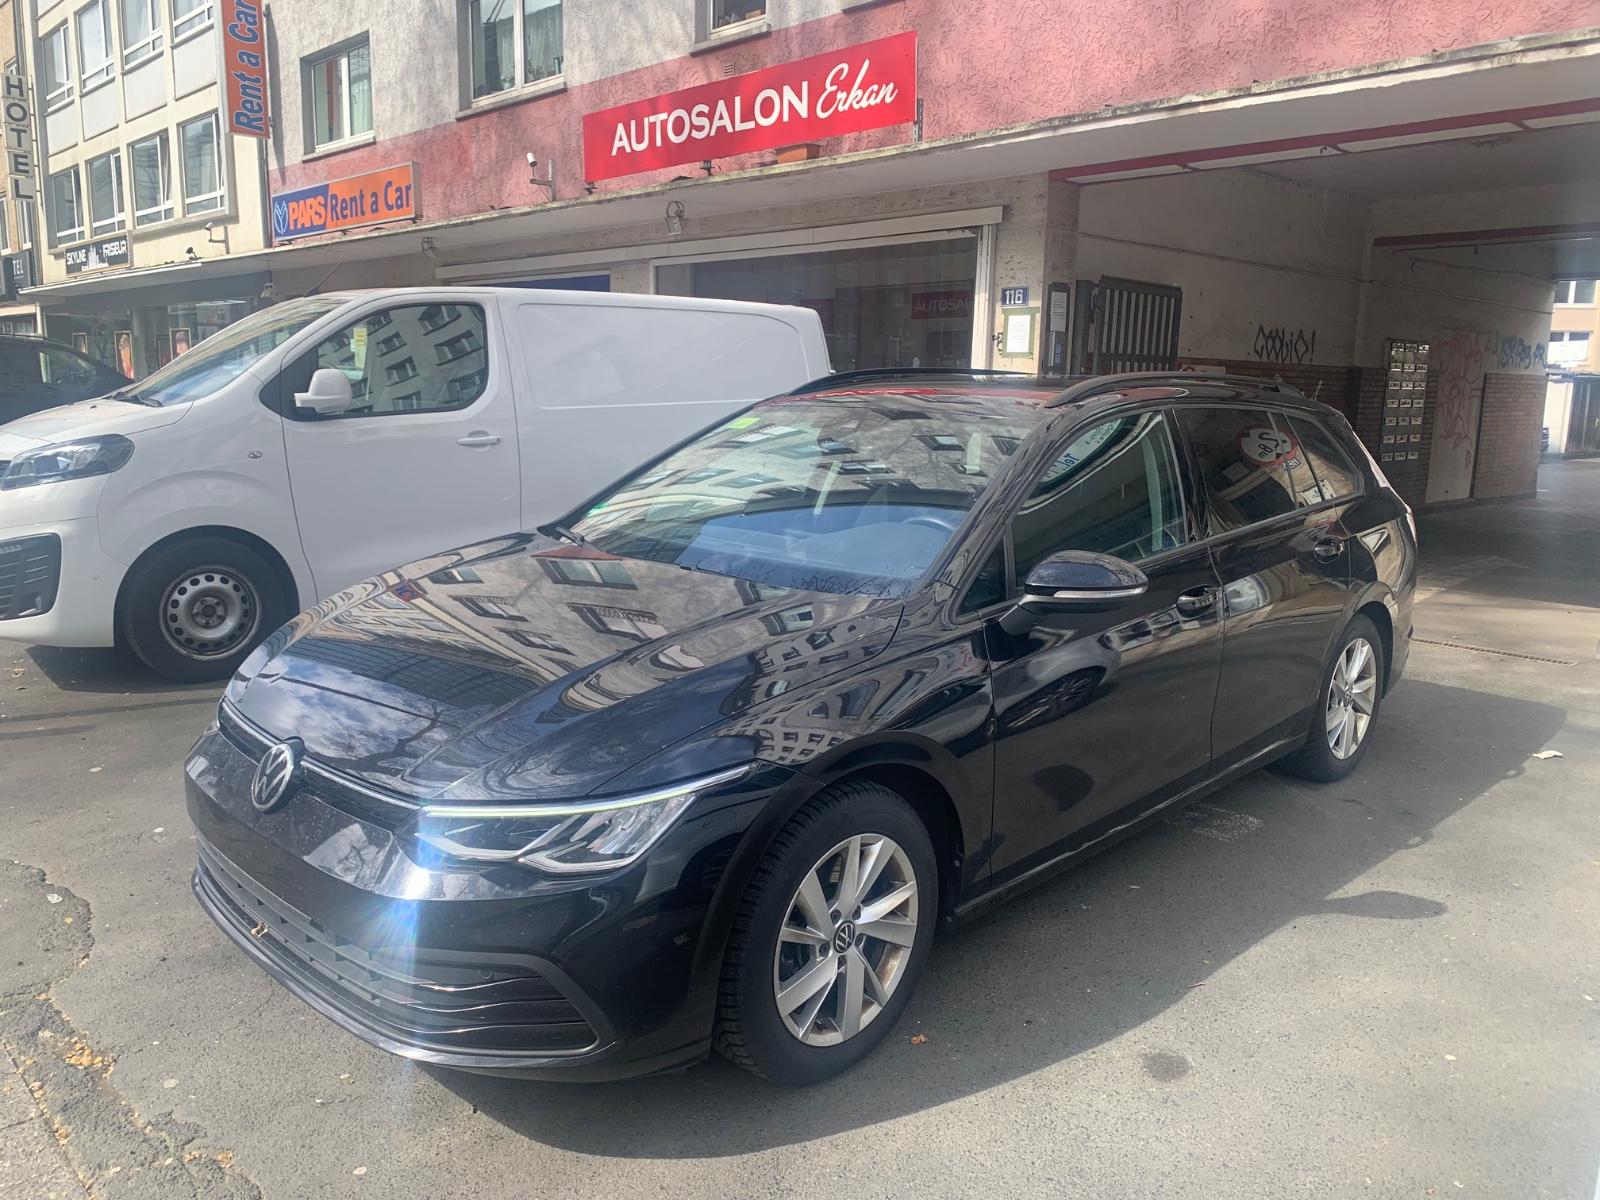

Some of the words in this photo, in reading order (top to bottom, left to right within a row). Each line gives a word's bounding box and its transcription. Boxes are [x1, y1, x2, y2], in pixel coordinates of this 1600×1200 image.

[227, 0, 259, 43] Car
[237, 50, 261, 69] a
[233, 71, 265, 132] Rent
[611, 80, 809, 156] AUTOSALON
[815, 58, 899, 119] Erkan
[6, 76, 34, 199] HOTEL
[288, 195, 327, 230] PARS
[329, 193, 366, 221] Rent
[370, 191, 379, 214] a
[383, 180, 412, 212] Car
[12, 257, 24, 276] TEL
[1005, 289, 1024, 305] 116
